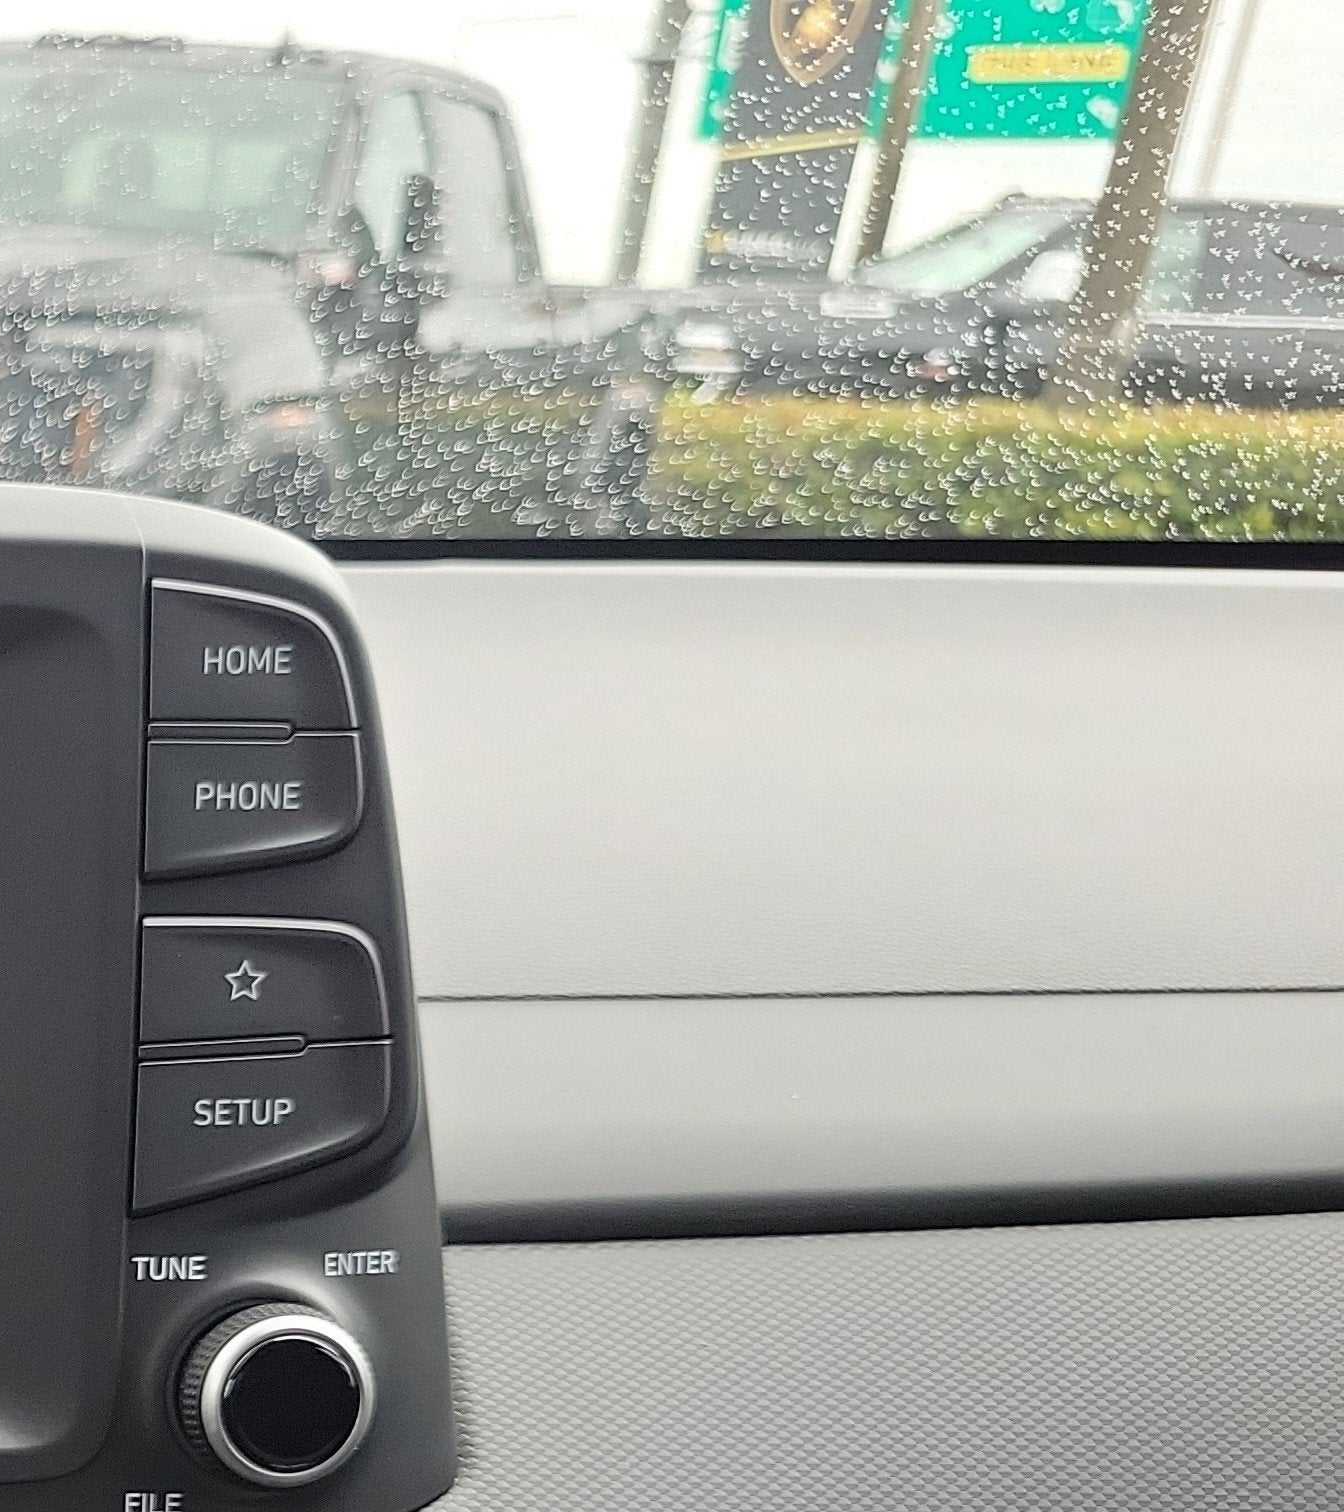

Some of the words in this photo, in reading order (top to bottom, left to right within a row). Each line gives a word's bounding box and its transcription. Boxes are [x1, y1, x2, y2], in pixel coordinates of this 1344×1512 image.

[203, 645, 292, 675] HOME
[195, 781, 301, 810] PHONE
[193, 1098, 294, 1126] SETUP
[131, 1255, 207, 1281] TUNE
[324, 1250, 397, 1277] ENTER
